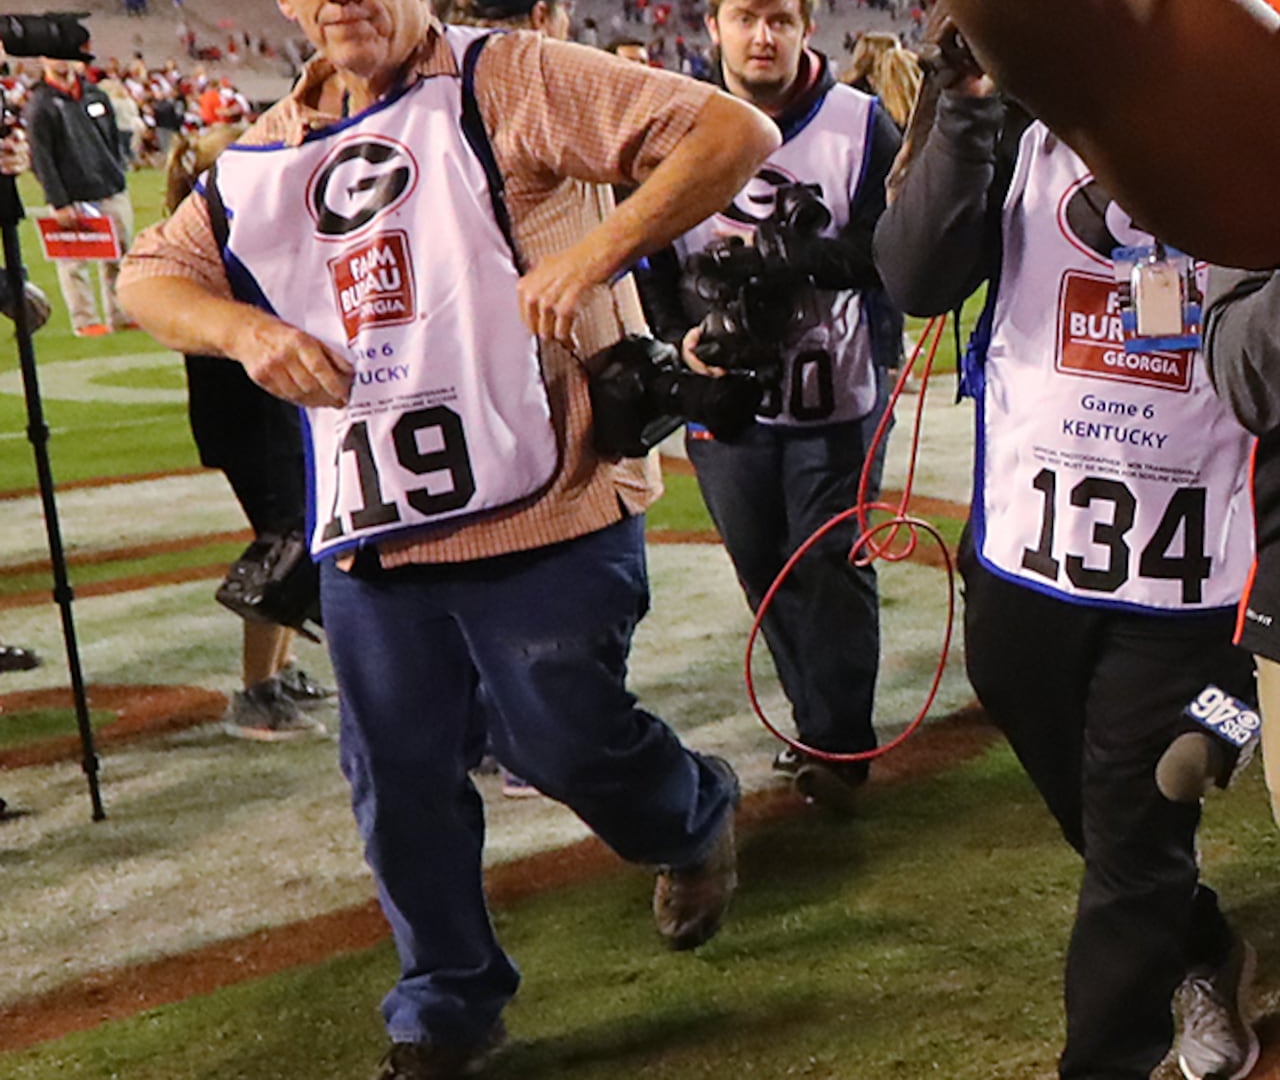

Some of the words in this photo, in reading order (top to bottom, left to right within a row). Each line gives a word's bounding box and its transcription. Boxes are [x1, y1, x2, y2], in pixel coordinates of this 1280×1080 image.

[313, 141, 412, 236] G
[1103, 351, 1179, 376] GEORGIA
[1081, 394, 1138, 417] Game
[1142, 404, 1155, 420] 6
[1063, 419, 1168, 450] KENTUCKY
[1021, 467, 1212, 604] 134
[1190, 687, 1240, 725] 46
[1219, 719, 1251, 744] CBS
